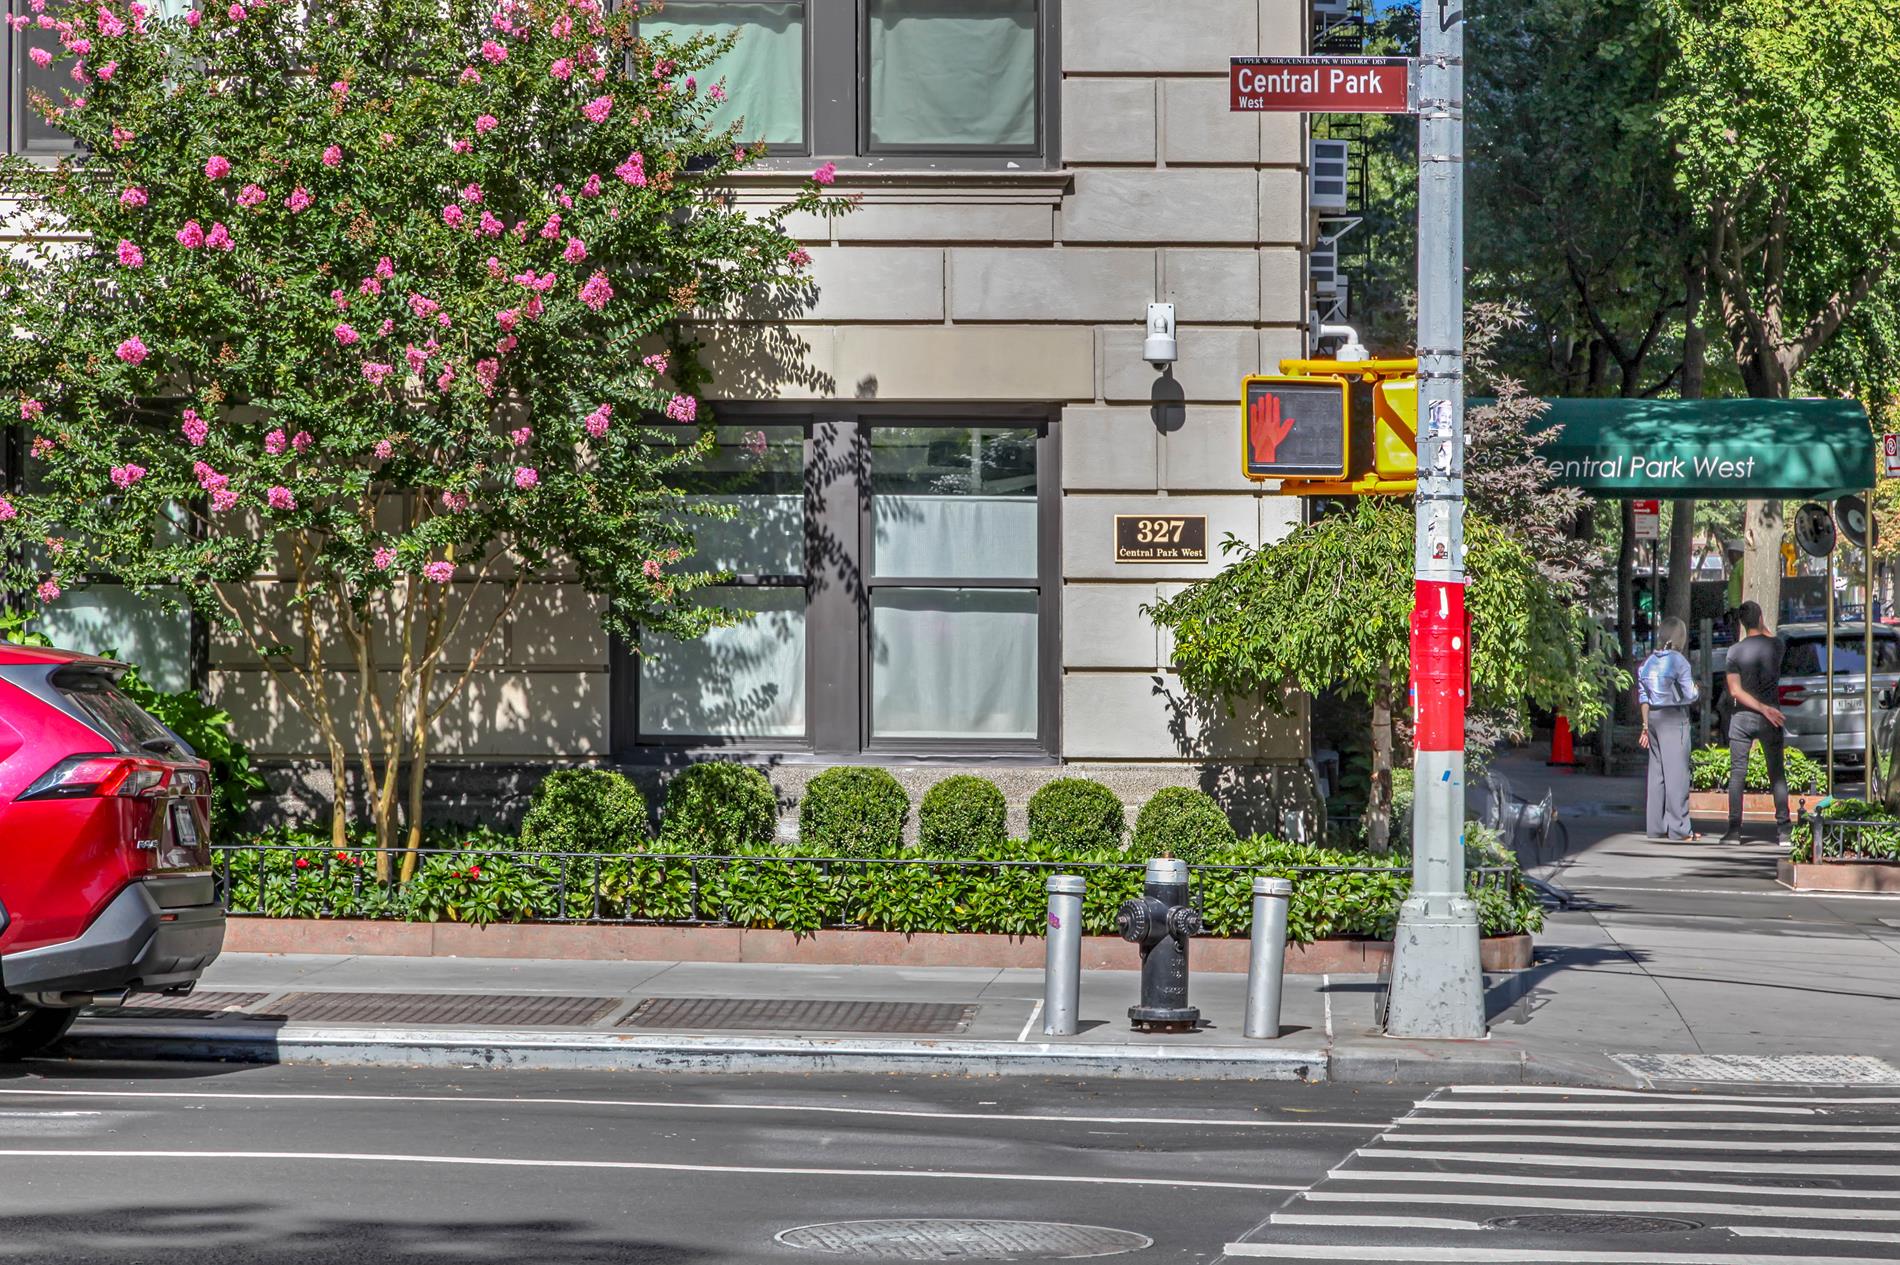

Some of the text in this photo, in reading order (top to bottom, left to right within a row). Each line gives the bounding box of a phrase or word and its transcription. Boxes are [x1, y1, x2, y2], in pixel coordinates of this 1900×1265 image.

[1238, 68, 1383, 94] Central Park
[1238, 96, 1264, 109] West
[1629, 455, 1685, 478] Park
[1692, 455, 1755, 478] West
[1137, 520, 1185, 542] 327
[1120, 548, 1203, 557] Central Park West
